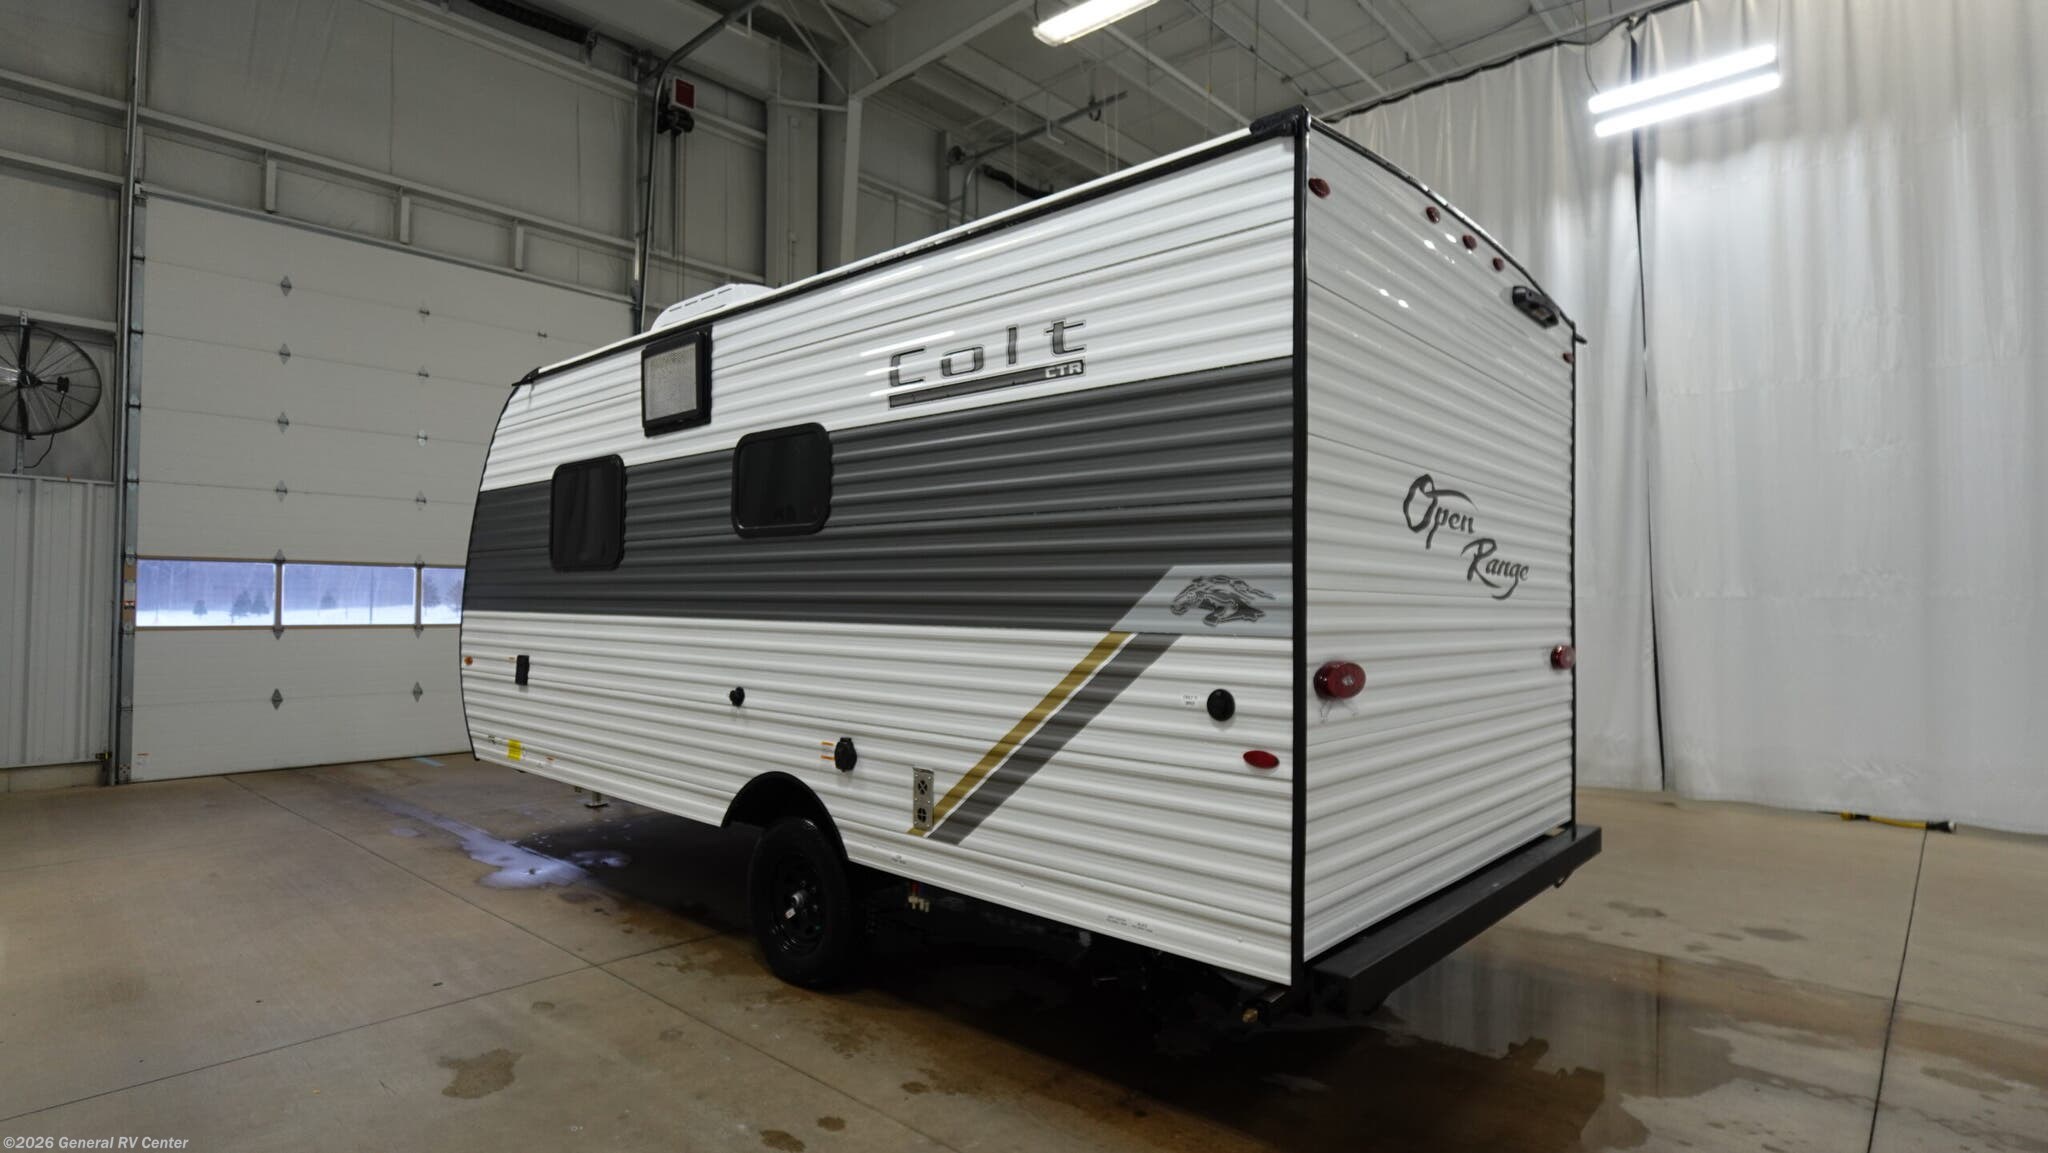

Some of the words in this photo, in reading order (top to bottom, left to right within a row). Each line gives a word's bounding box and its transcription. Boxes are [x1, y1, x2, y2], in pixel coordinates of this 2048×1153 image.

[888, 319, 1086, 388] Colt
[1044, 363, 1083, 379] CTR
[1403, 473, 1479, 550] Open
[1460, 538, 1530, 600] Range
